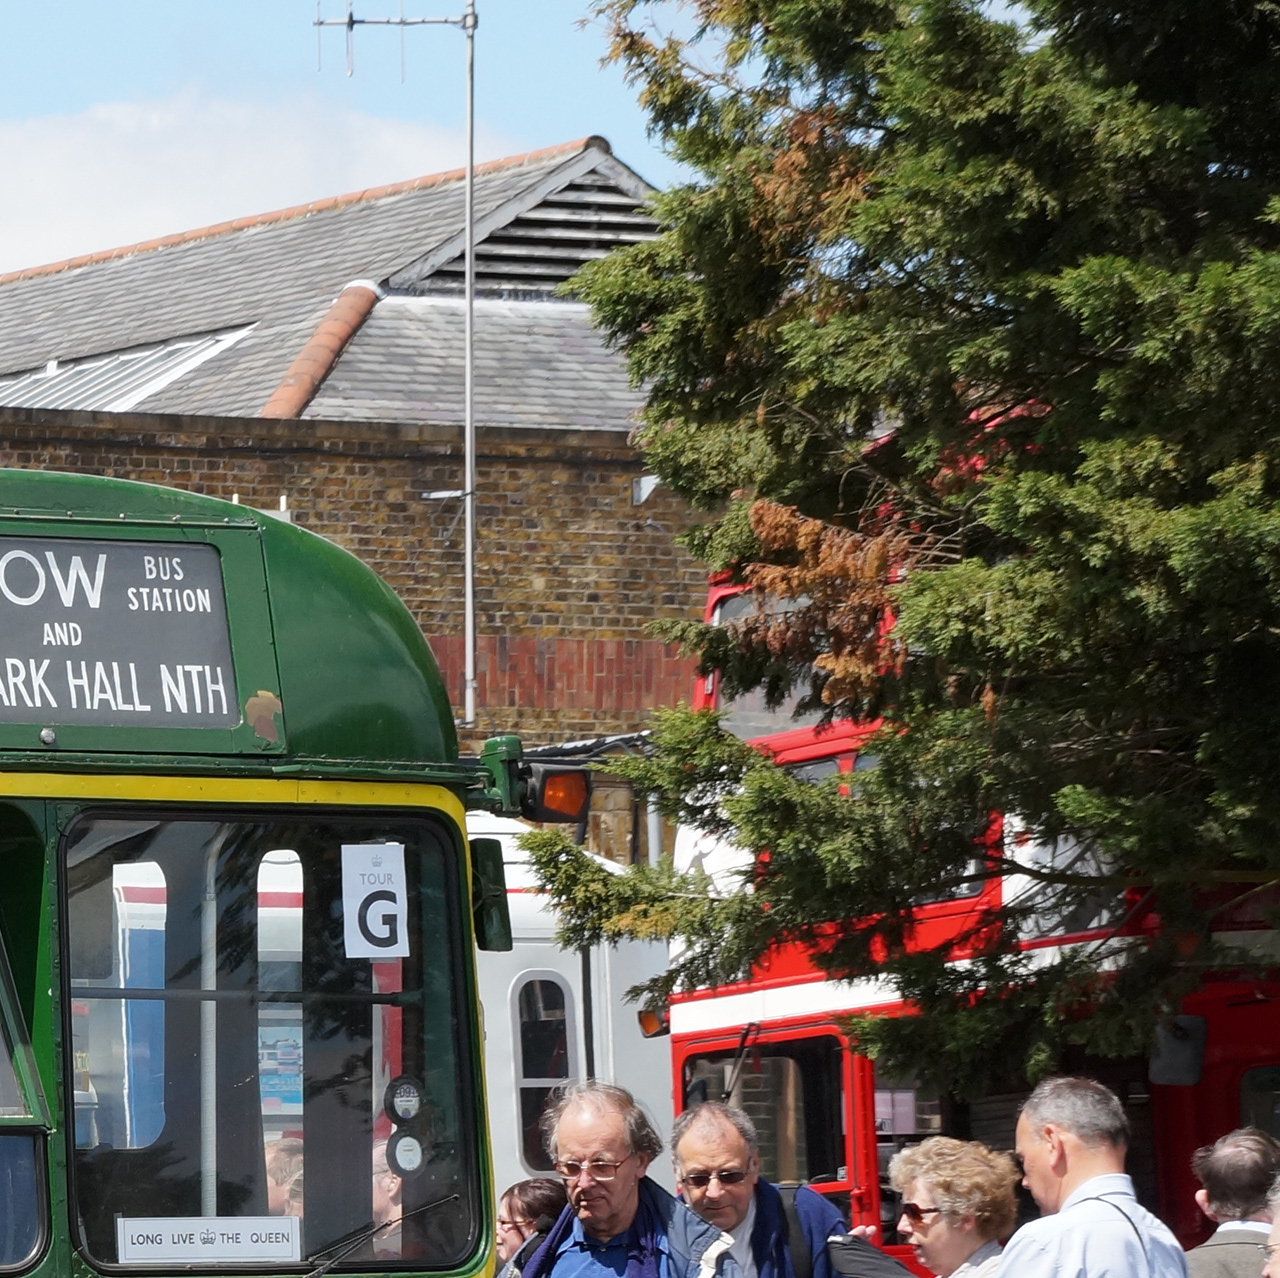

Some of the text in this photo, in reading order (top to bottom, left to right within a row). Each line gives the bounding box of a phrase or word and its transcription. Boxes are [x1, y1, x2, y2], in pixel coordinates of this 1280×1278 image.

[144, 556, 184, 582] BUS
[127, 587, 212, 614] STATION
[42, 622, 83, 647] AND
[66, 660, 151, 713] HALL
[159, 663, 229, 715] NTH
[359, 873, 395, 885] TOUR
[357, 889, 399, 948] G
[130, 1232, 290, 1245] LONG LIVE THE QUEEN
